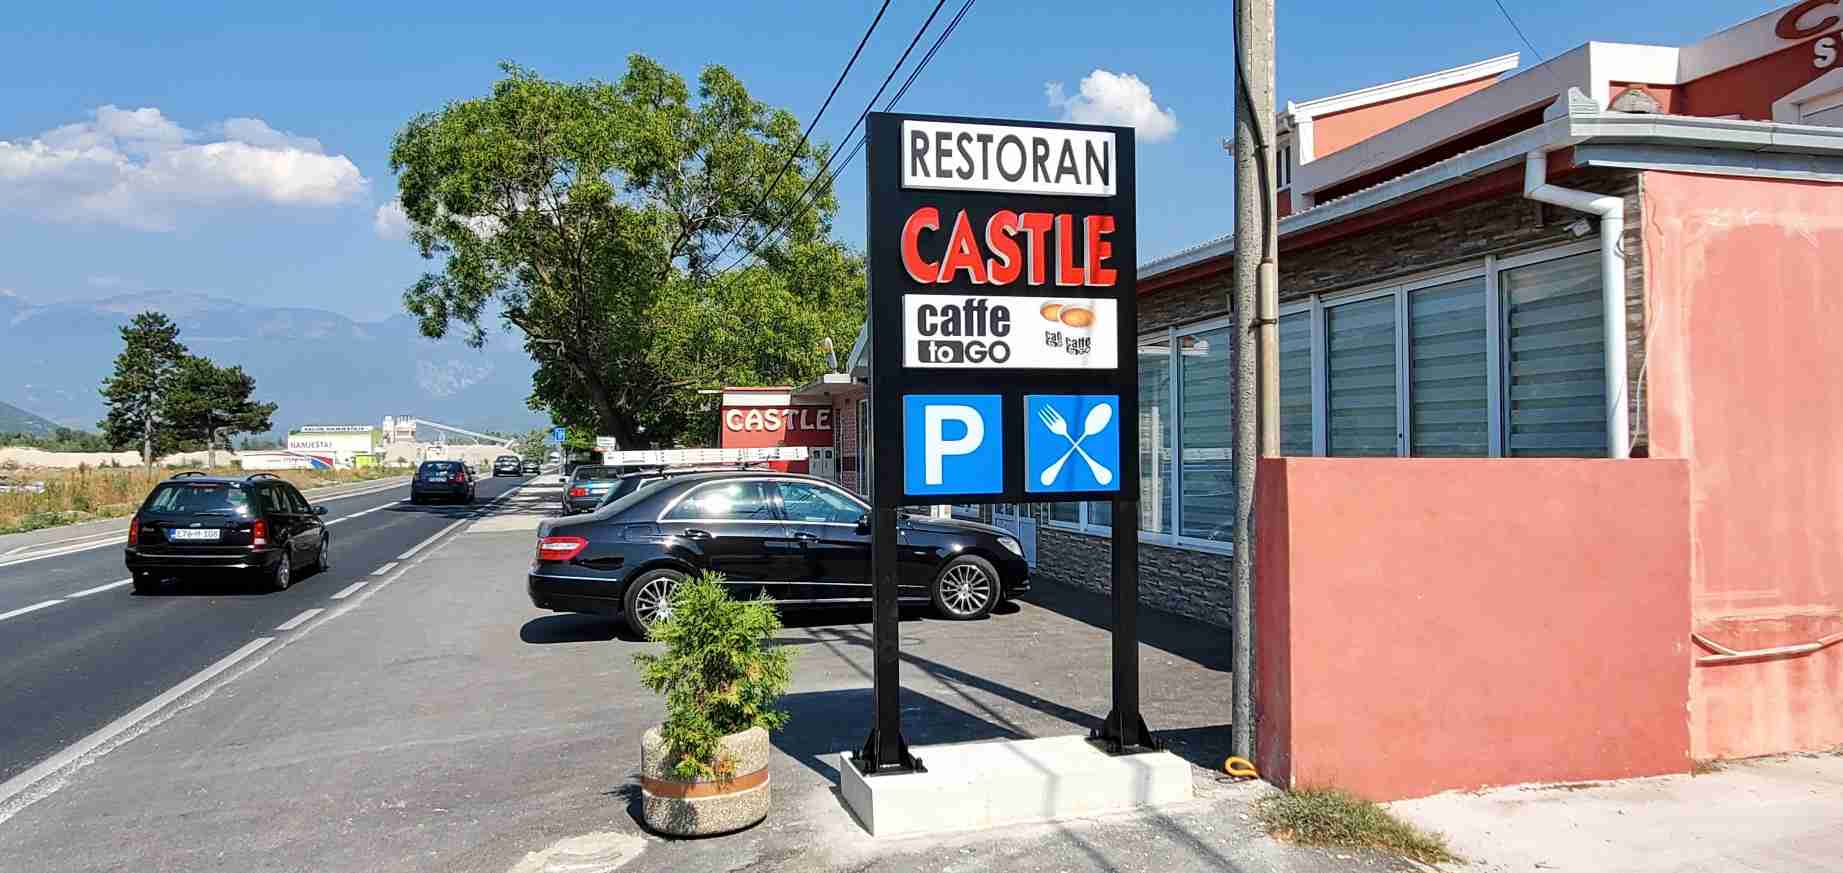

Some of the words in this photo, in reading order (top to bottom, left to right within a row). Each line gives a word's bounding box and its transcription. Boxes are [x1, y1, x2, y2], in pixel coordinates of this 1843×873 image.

[911, 129, 1110, 187] RESTORAN
[901, 207, 1118, 286] CASTLE
[917, 298, 1010, 337] caffe
[726, 408, 832, 432] CASTLE
[925, 404, 985, 485] P
